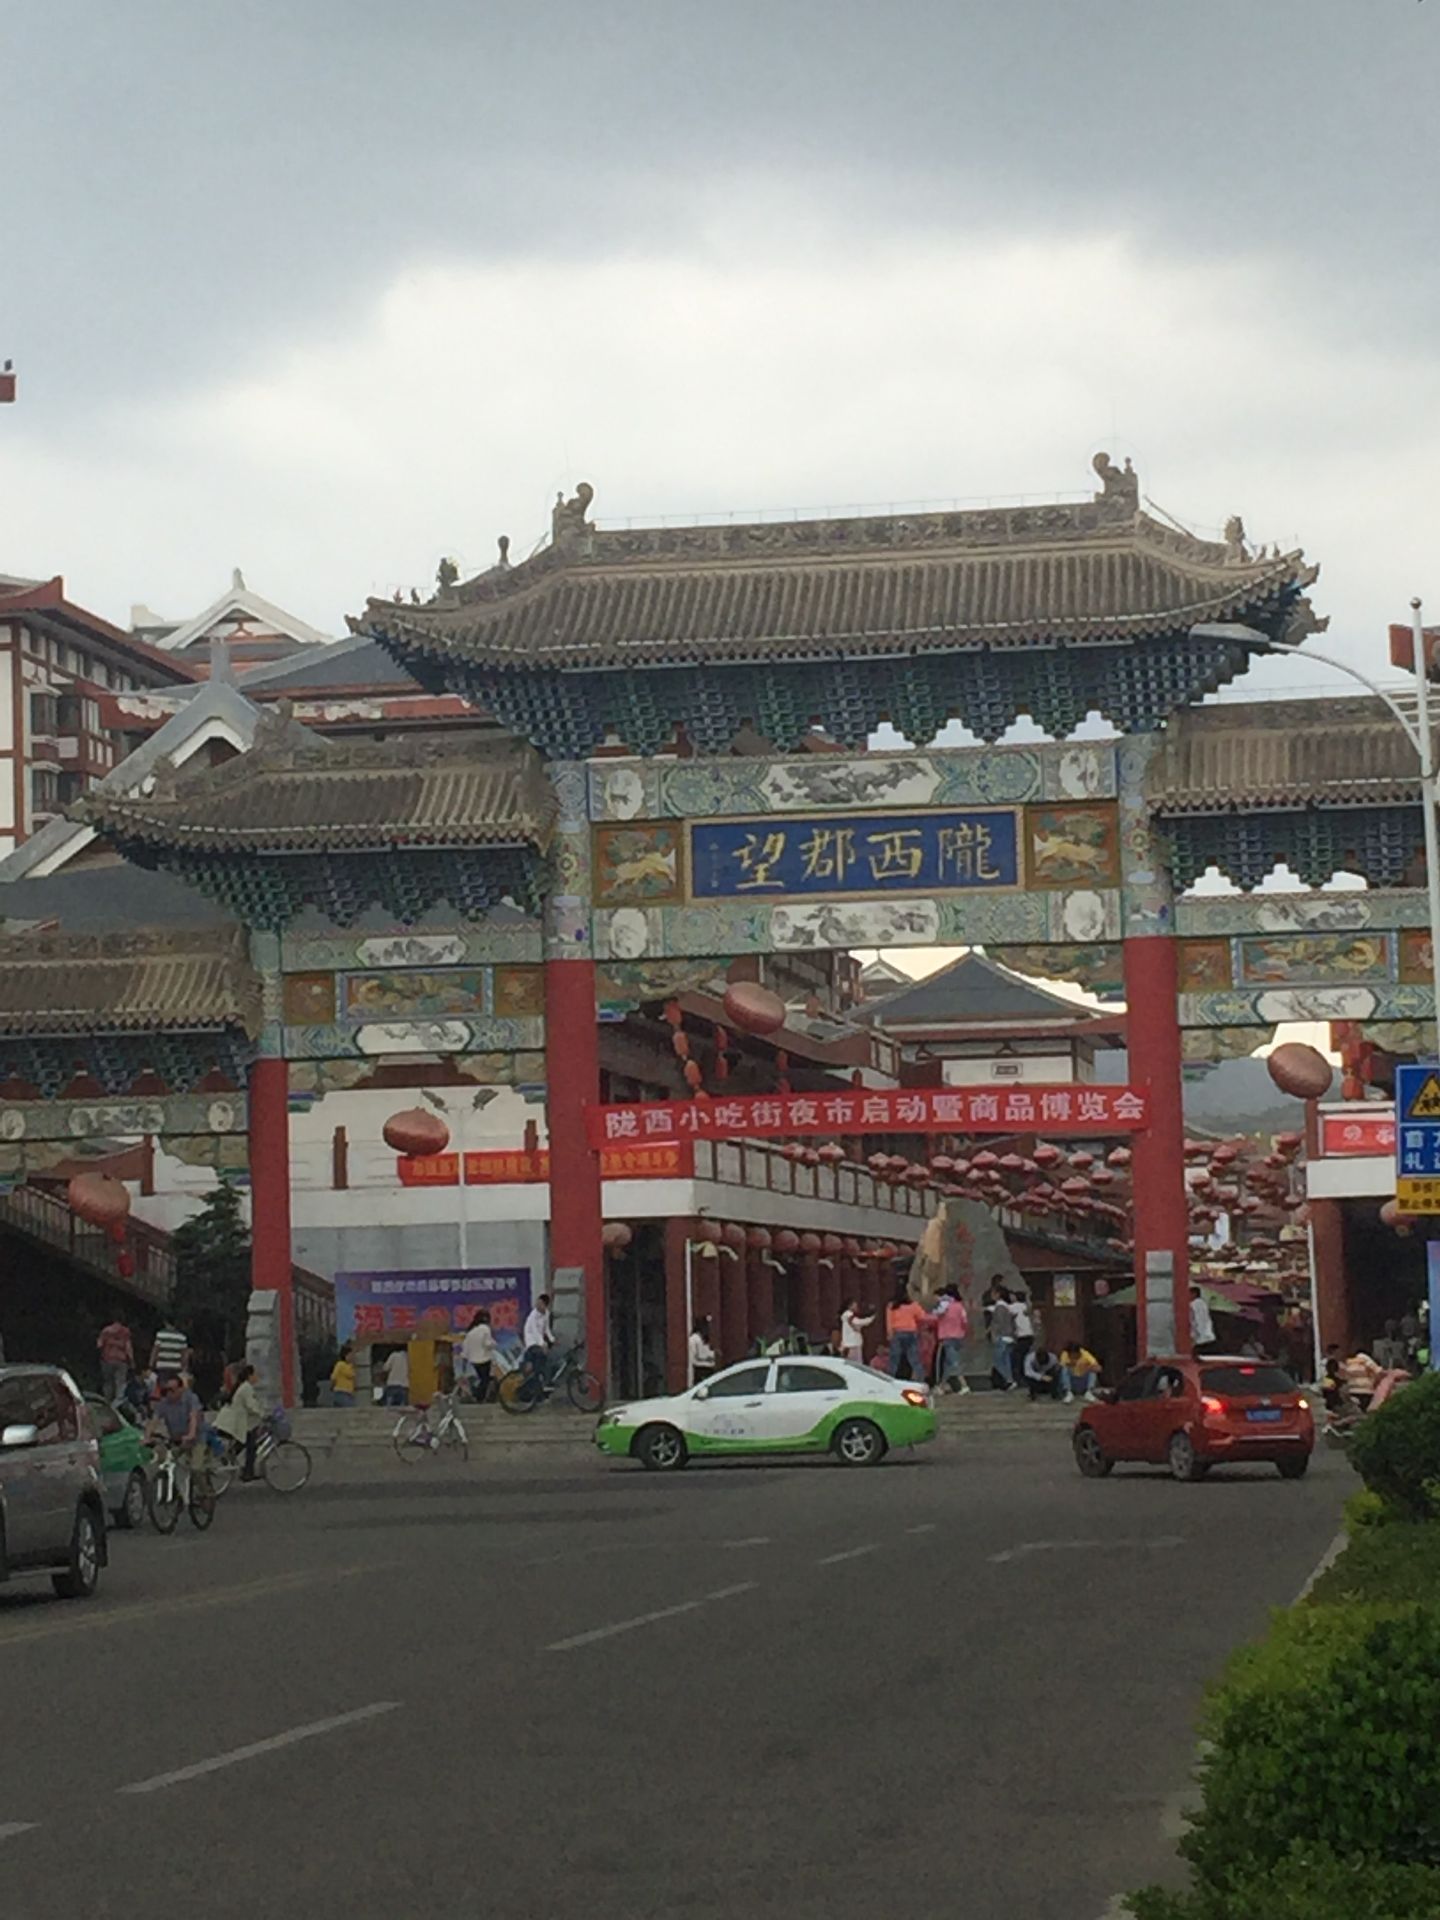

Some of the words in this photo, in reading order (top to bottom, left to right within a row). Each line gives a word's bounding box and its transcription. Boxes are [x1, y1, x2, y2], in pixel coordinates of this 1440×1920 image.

[606, 1091, 1145, 1139] 陇西小吃街夜市启动暨商品博览会
